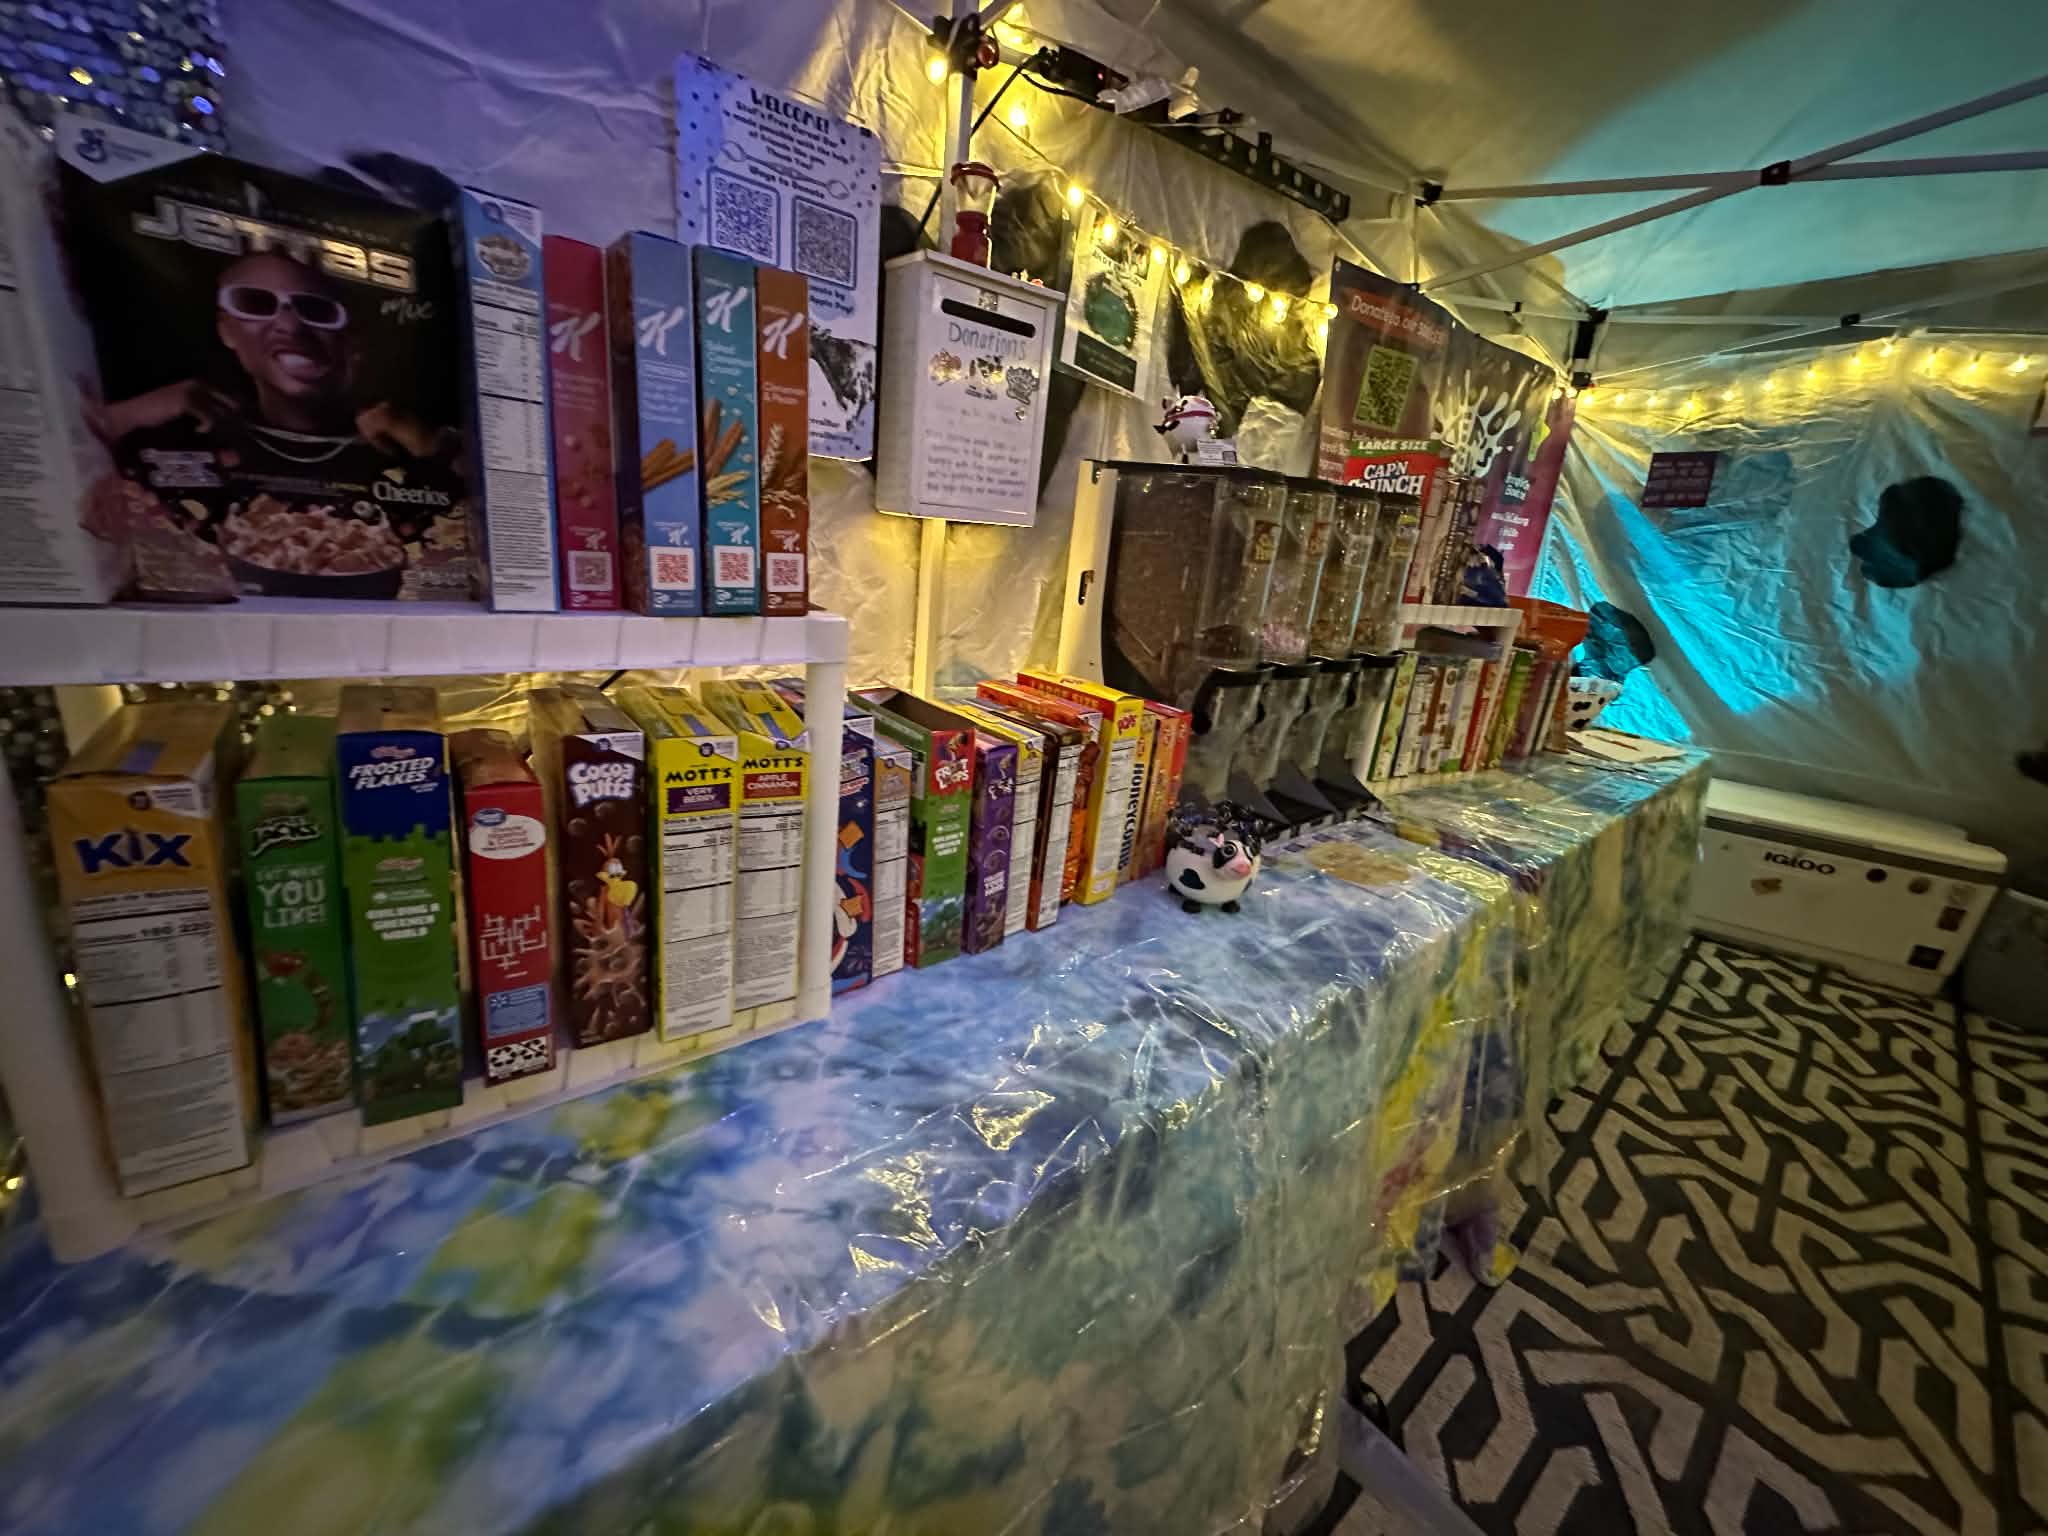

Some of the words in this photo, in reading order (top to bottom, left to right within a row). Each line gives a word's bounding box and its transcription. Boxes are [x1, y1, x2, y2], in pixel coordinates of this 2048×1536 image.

[949, 322, 1028, 361] Donations
[1358, 440, 1397, 451] LARGE
[1400, 440, 1430, 451] SIZE
[372, 480, 450, 507] Cheerios
[349, 757, 435, 779] FROSTED
[355, 769, 427, 791] FLAKES
[1764, 851, 1836, 876] IGLOO
[258, 878, 327, 907] YOU
